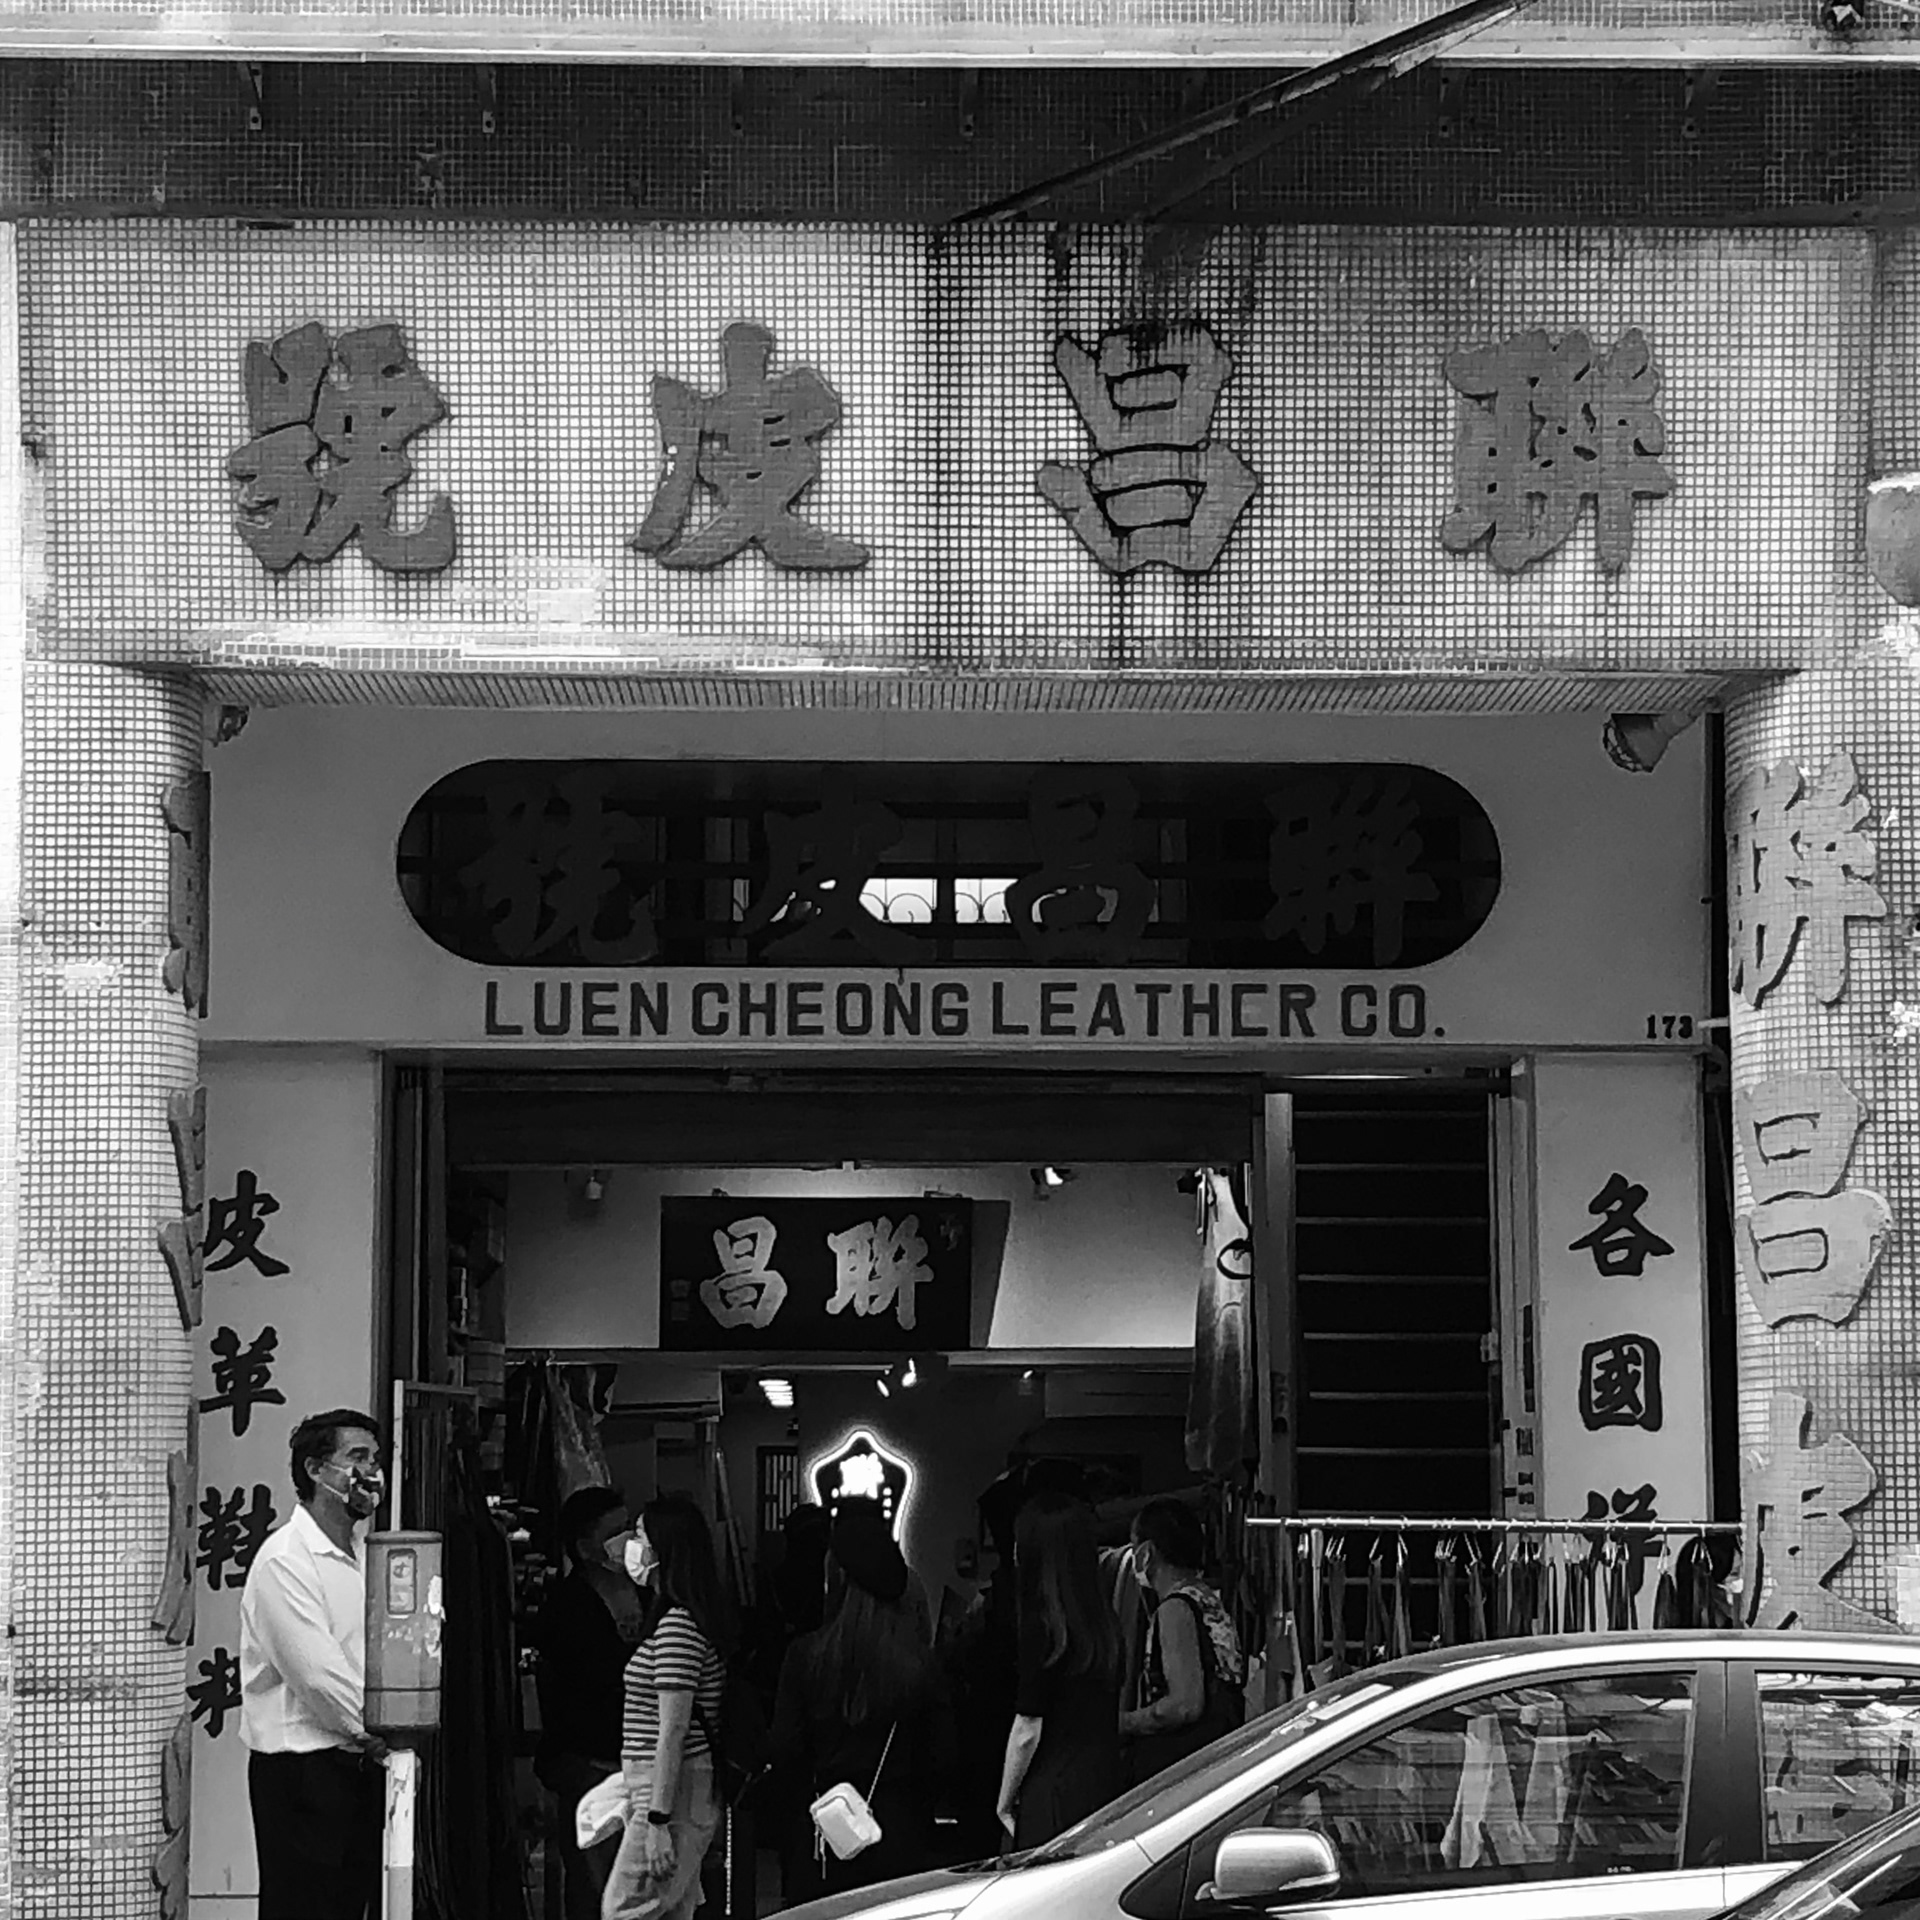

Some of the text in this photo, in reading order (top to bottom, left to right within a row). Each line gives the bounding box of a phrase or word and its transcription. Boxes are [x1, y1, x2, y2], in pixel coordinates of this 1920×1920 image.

[485, 981, 668, 1036] LUEN
[691, 982, 969, 1037] CHEONG
[1340, 984, 1446, 1038] CO.
[1646, 1014, 1693, 1040] 173
